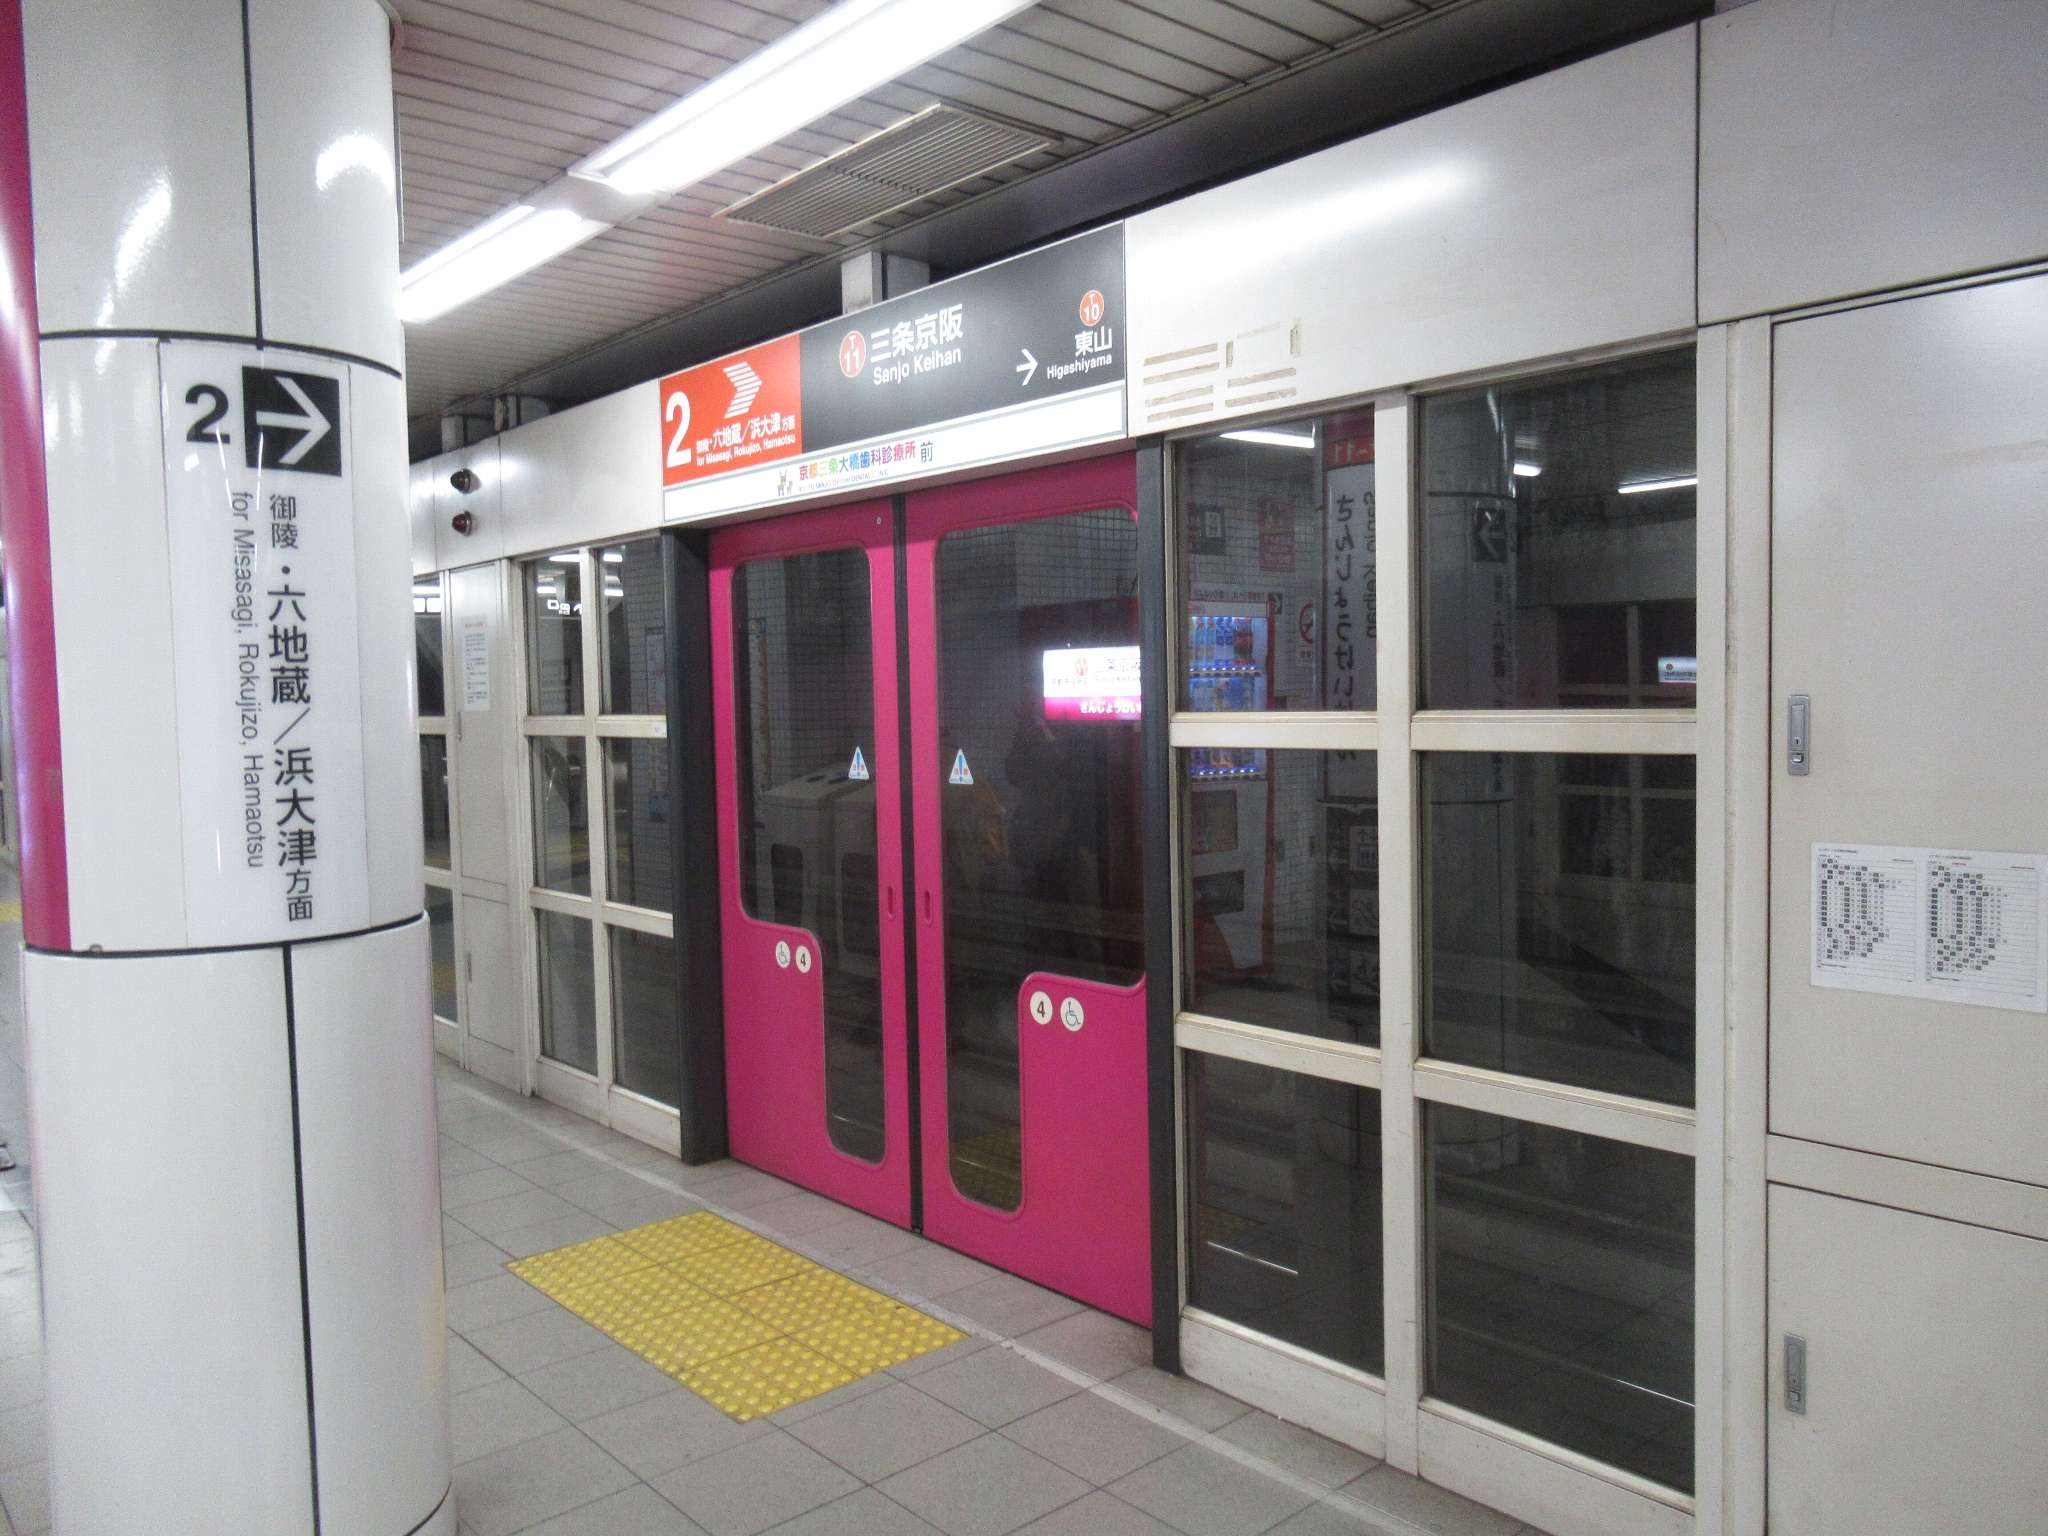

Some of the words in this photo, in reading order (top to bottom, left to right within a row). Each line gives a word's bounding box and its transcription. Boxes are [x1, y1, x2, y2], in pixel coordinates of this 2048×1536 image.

[1083, 303, 1101, 322] 10
[870, 304, 963, 363] 三条京阪
[1075, 325, 1113, 357] 東山
[844, 348, 861, 373] 11
[873, 361, 910, 386] Sanjo
[914, 348, 962, 375] Keihan
[1046, 353, 1113, 380] Higashiyama
[185, 383, 231, 444] 2
[665, 390, 692, 468] 2
[920, 440, 935, 463] 前
[232, 491, 254, 521] for
[231, 529, 259, 634] Misasagi,
[235, 643, 260, 745] Rokujizo,
[243, 754, 266, 868] Hamaotsu
[1037, 1000, 1046, 1018] 4
